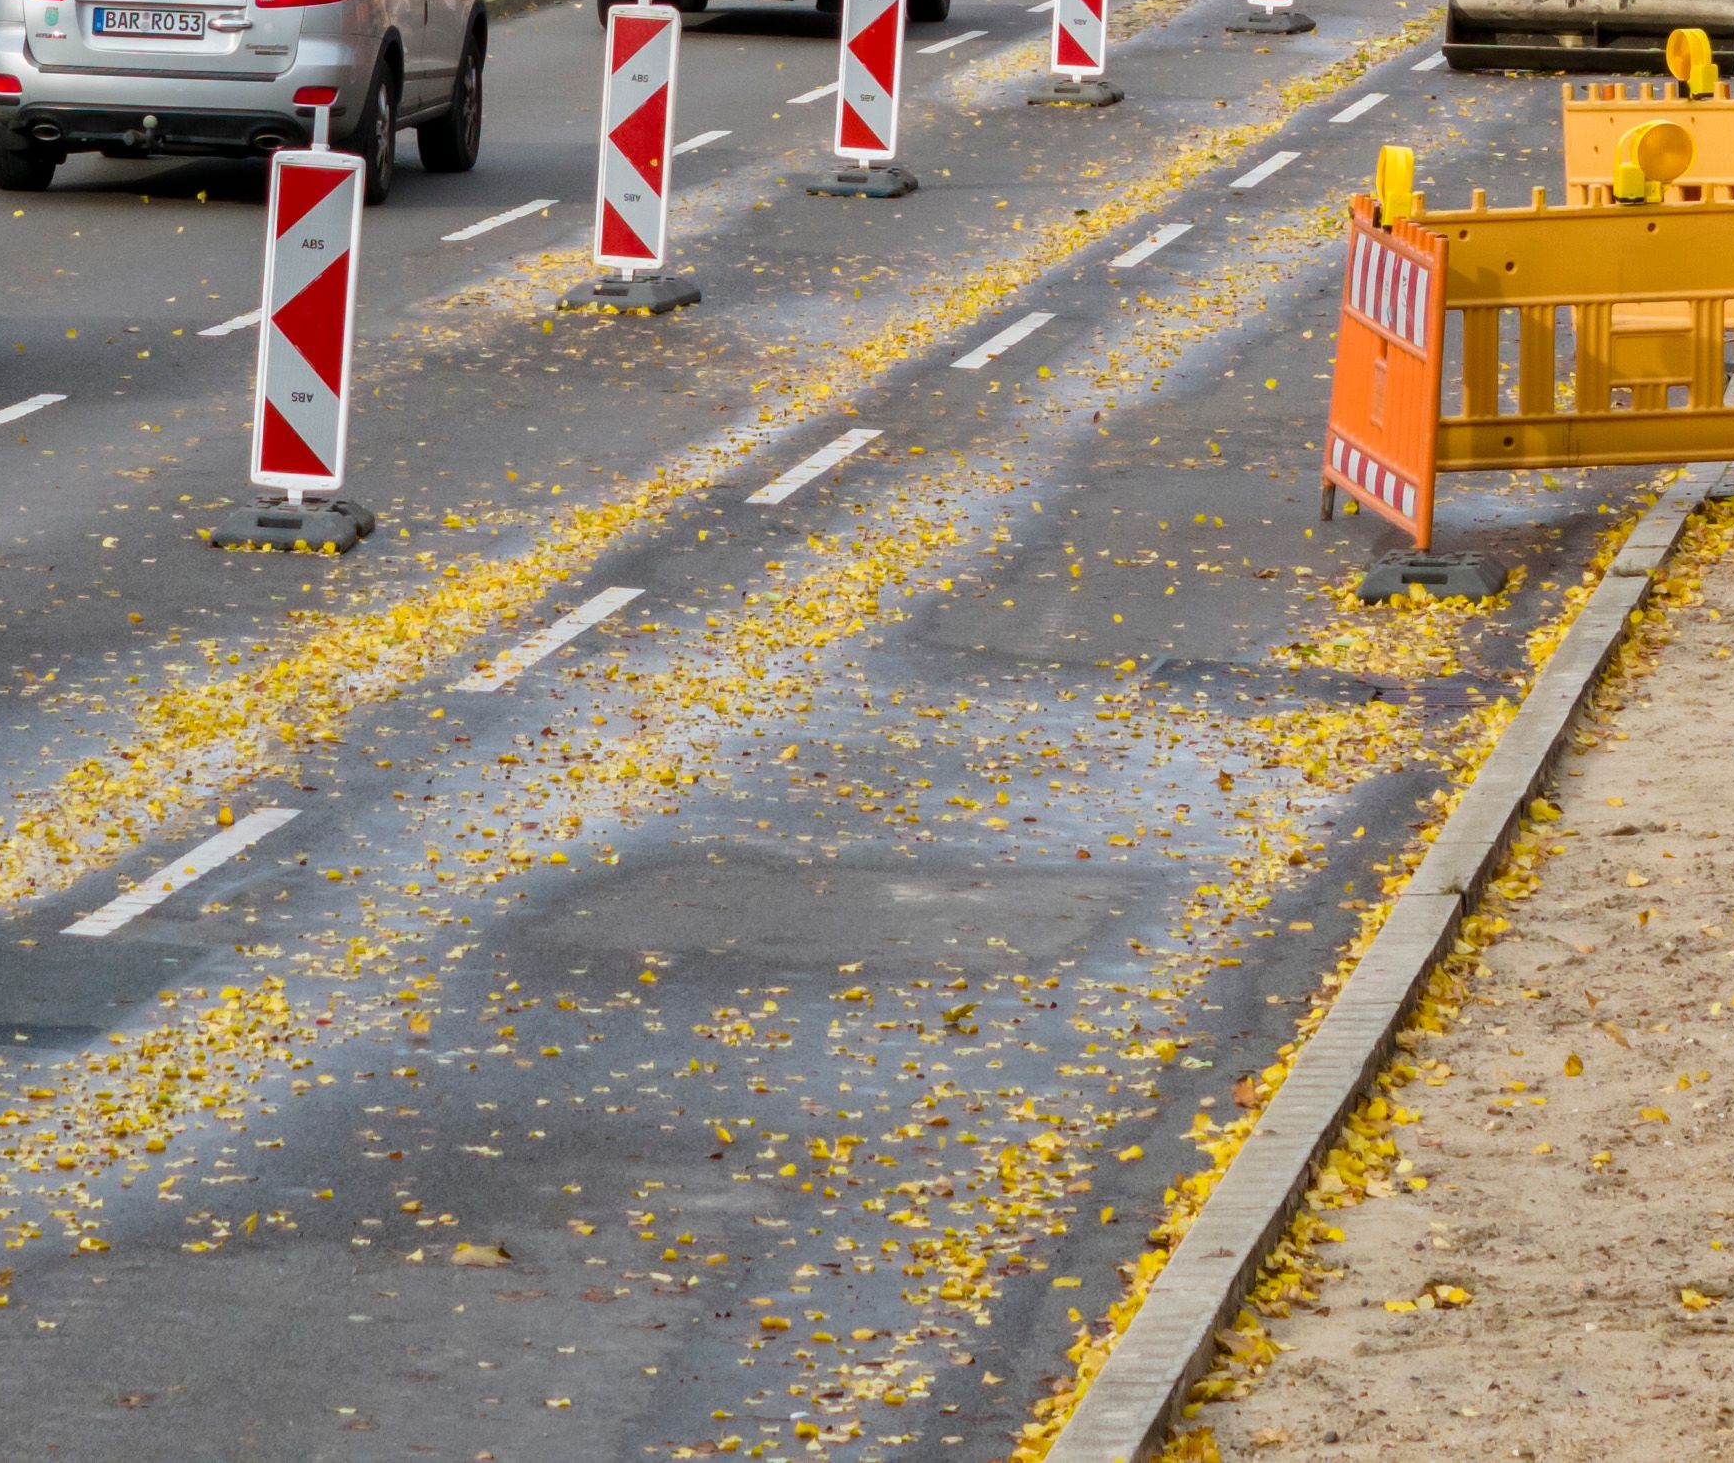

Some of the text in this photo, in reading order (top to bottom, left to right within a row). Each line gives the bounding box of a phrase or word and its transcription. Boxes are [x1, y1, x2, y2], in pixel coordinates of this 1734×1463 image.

[105, 11, 202, 32] BAR RO 53
[301, 238, 325, 250] ABS
[291, 391, 315, 403] ABS
